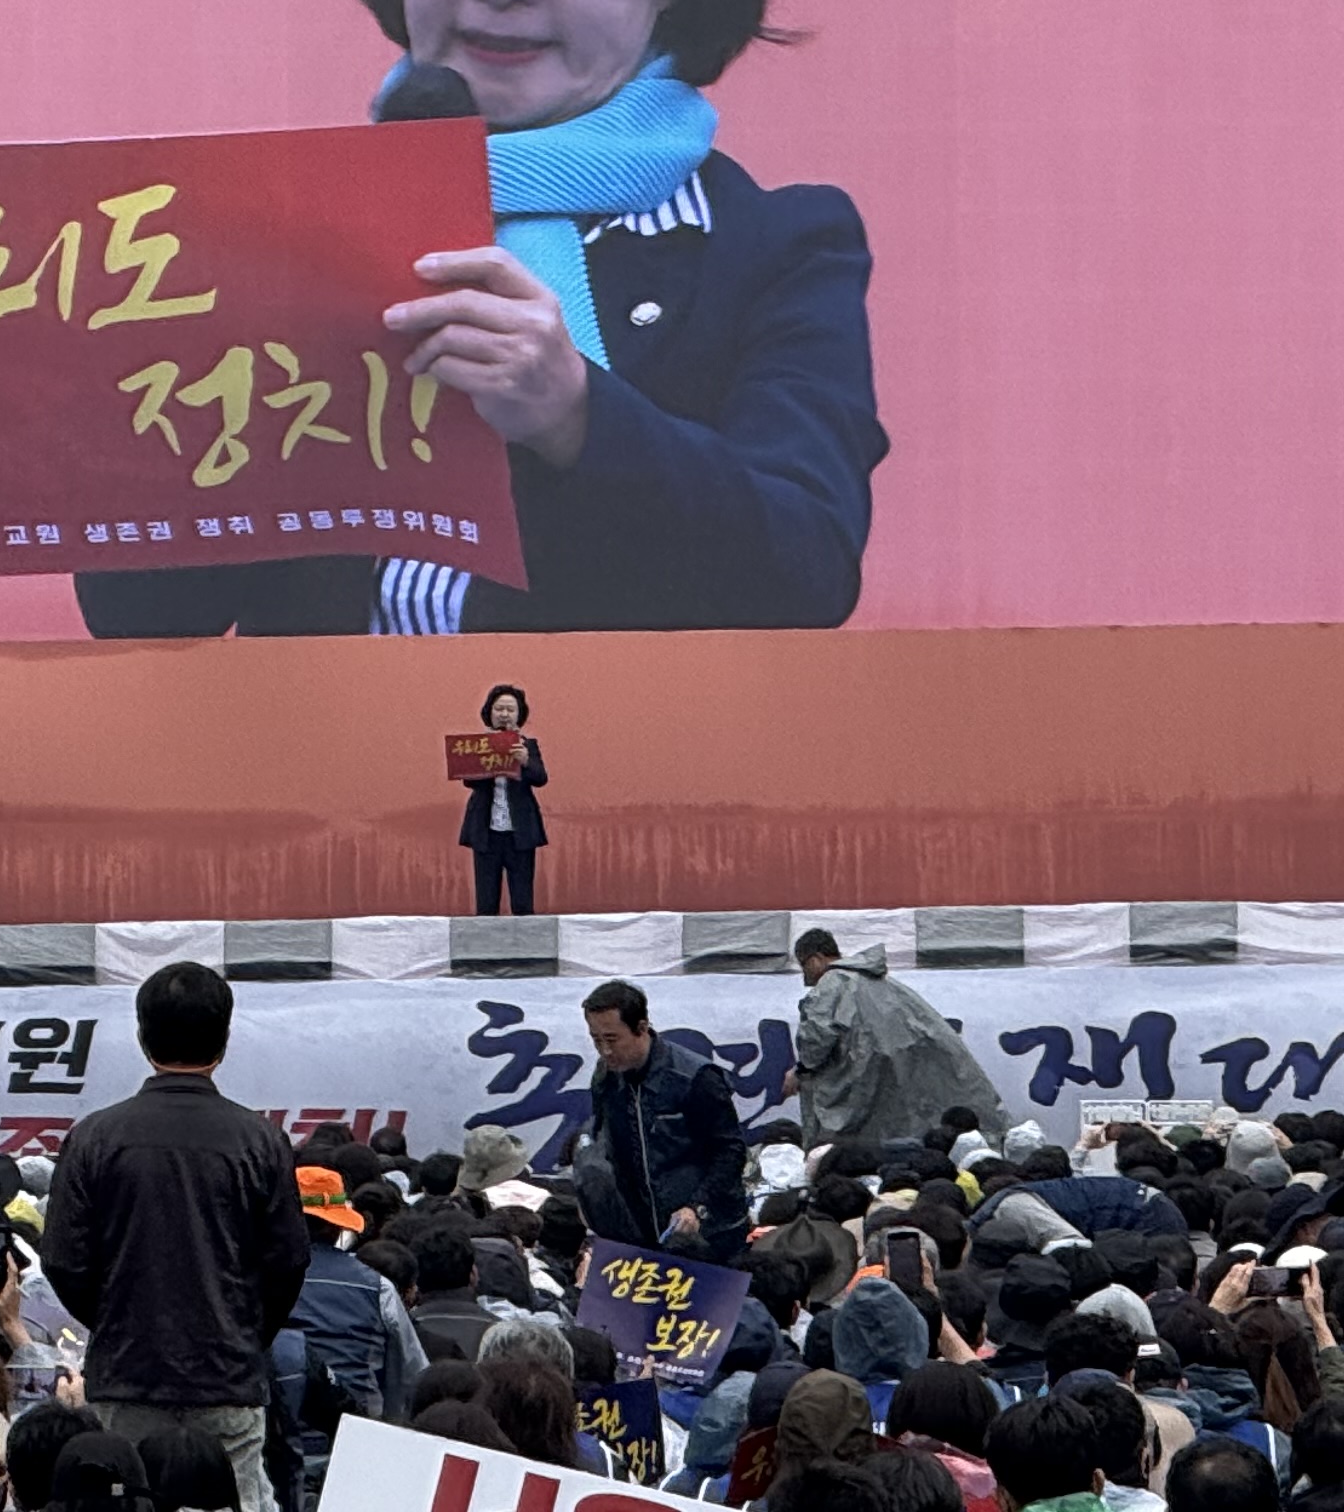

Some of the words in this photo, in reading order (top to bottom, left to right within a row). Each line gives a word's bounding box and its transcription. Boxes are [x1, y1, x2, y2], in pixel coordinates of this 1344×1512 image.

[117, 341, 439, 487] 정치!
[84, 520, 174, 544] 생존권
[195, 515, 254, 537] 쟁취
[276, 508, 479, 544] 공동투쟁위원회
[600, 1256, 695, 1310] 생존권
[645, 1312, 722, 1360] 보장!
